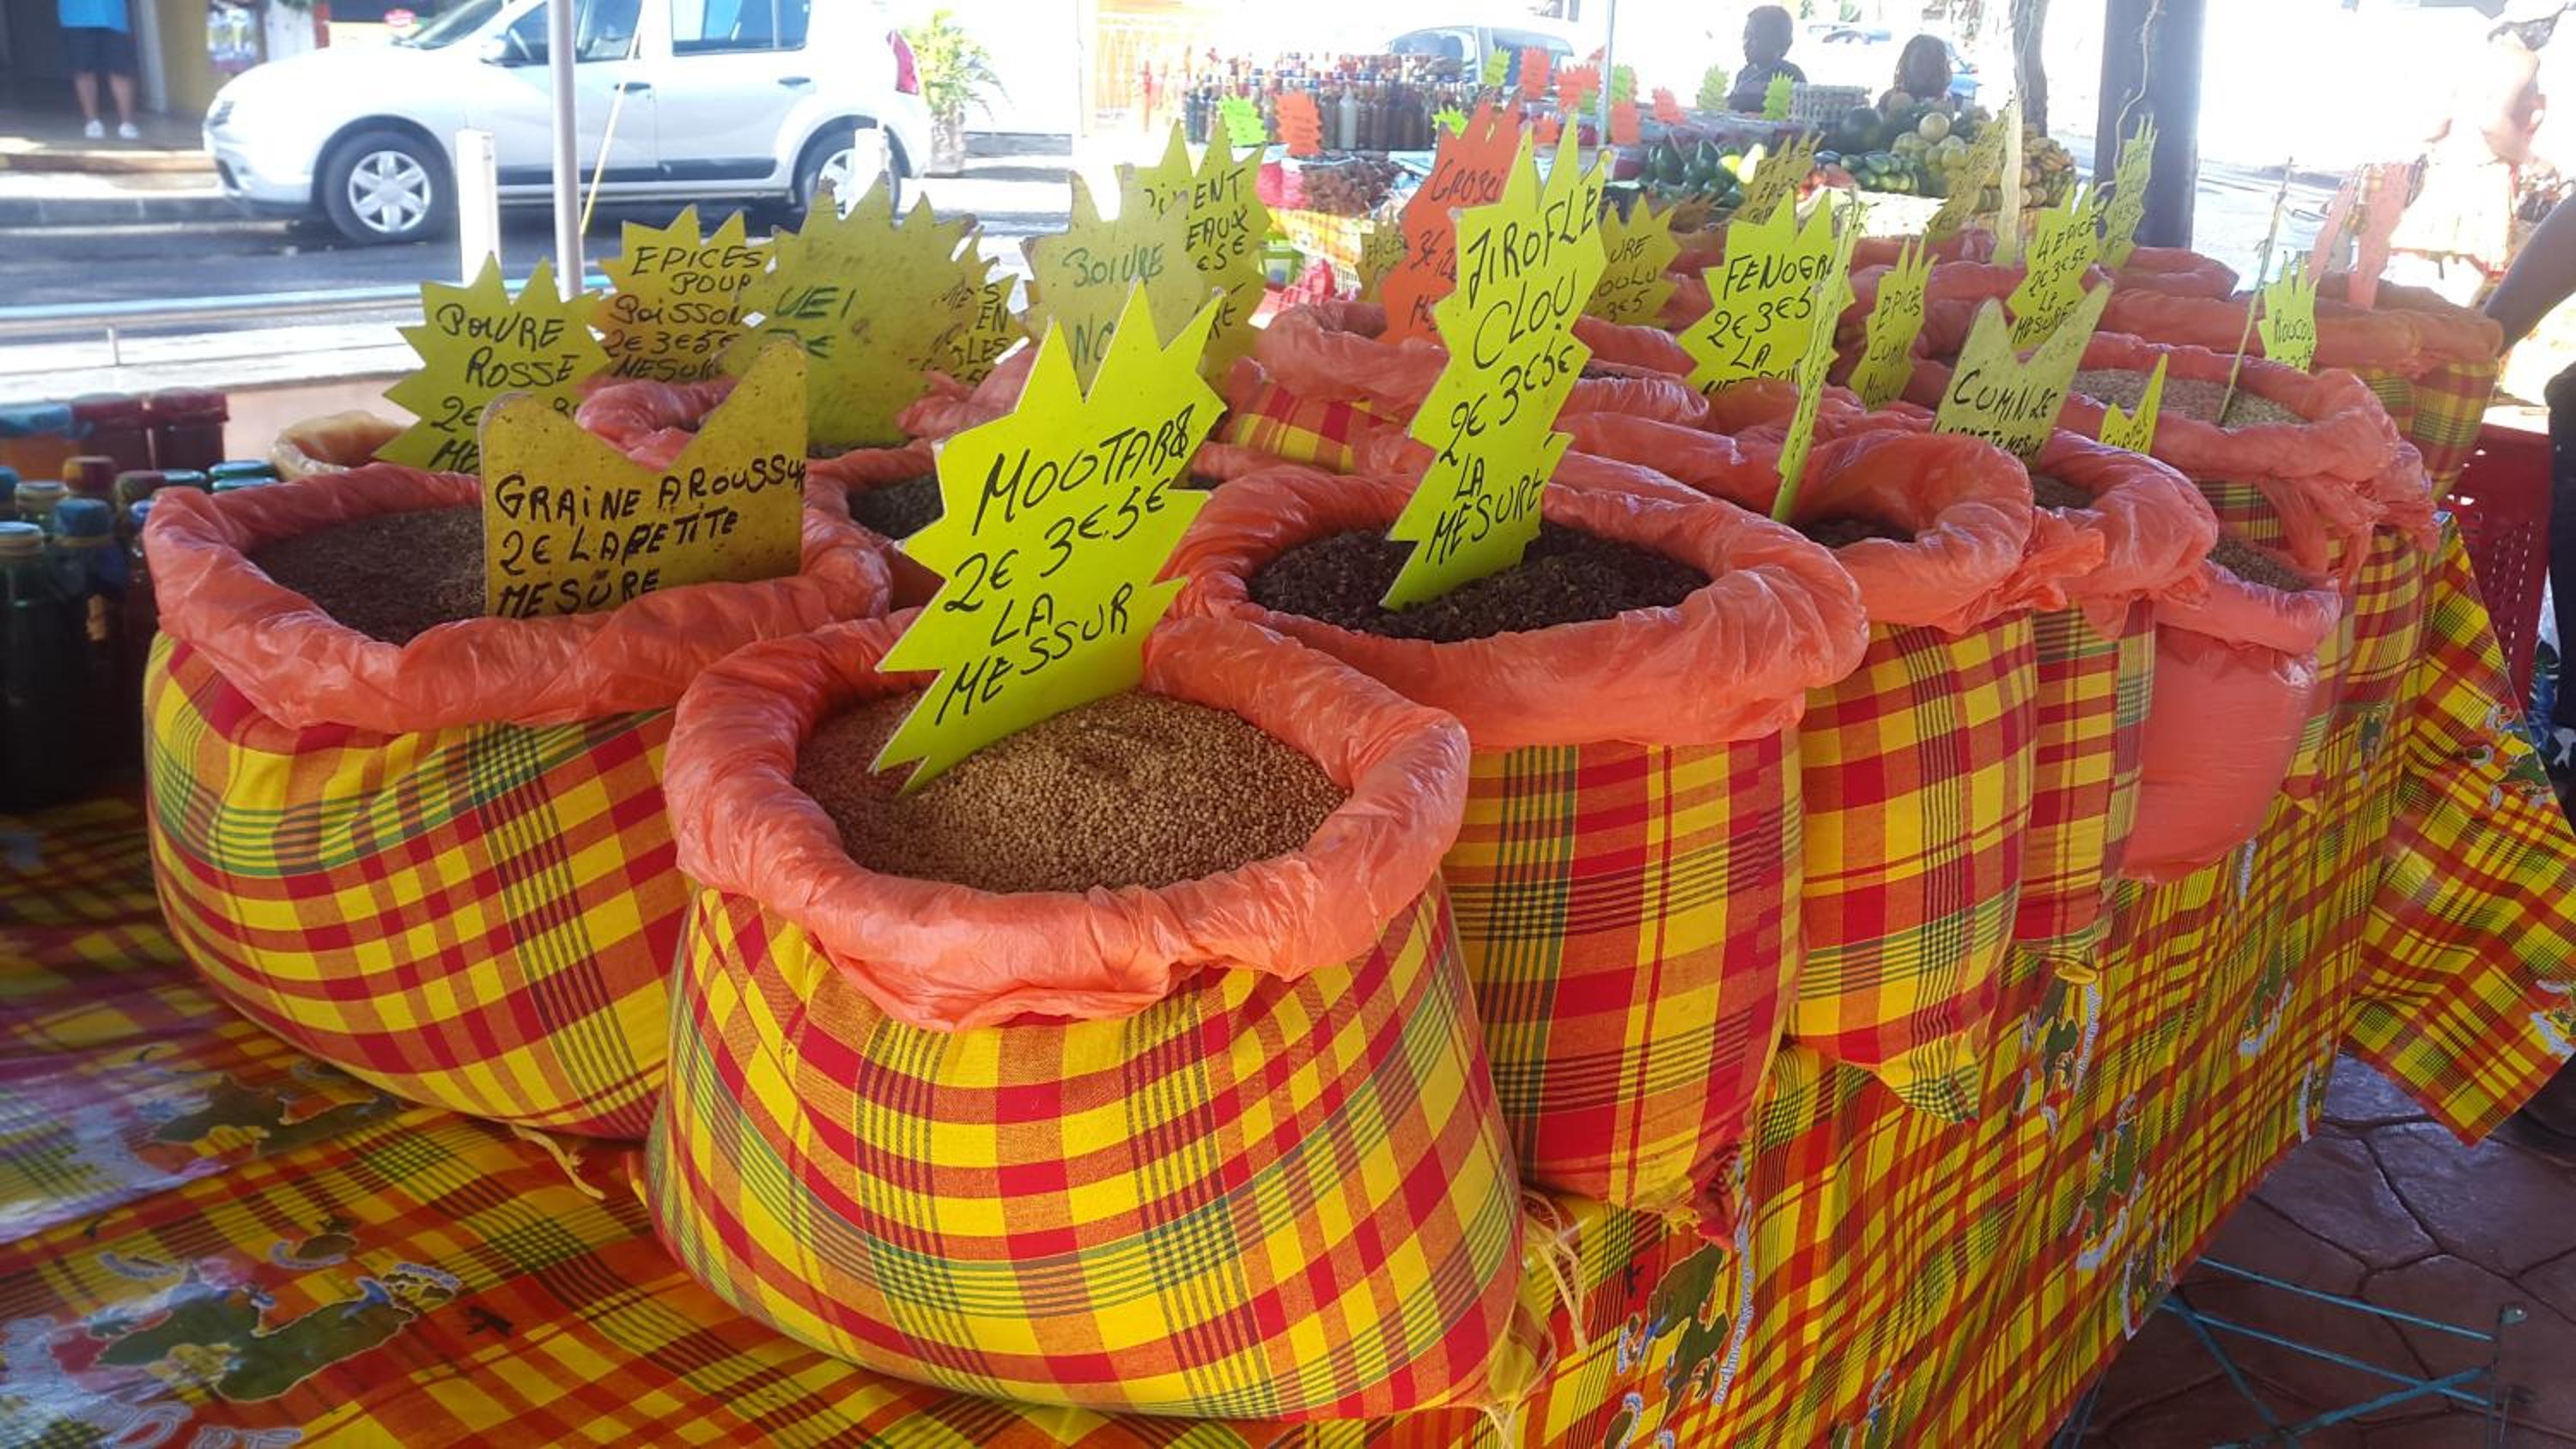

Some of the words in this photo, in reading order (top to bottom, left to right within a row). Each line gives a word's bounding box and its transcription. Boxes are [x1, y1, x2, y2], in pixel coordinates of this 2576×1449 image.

[631, 245, 764, 276] EPICES
[465, 345, 580, 388] ROSSE
[1729, 336, 1771, 372] LA
[1953, 368, 2033, 422] CUMIN
[495, 473, 642, 527] GRAINE
[1425, 440, 1555, 567] MESURE
[1455, 456, 1485, 503] LA
[990, 592, 1054, 648] LA
